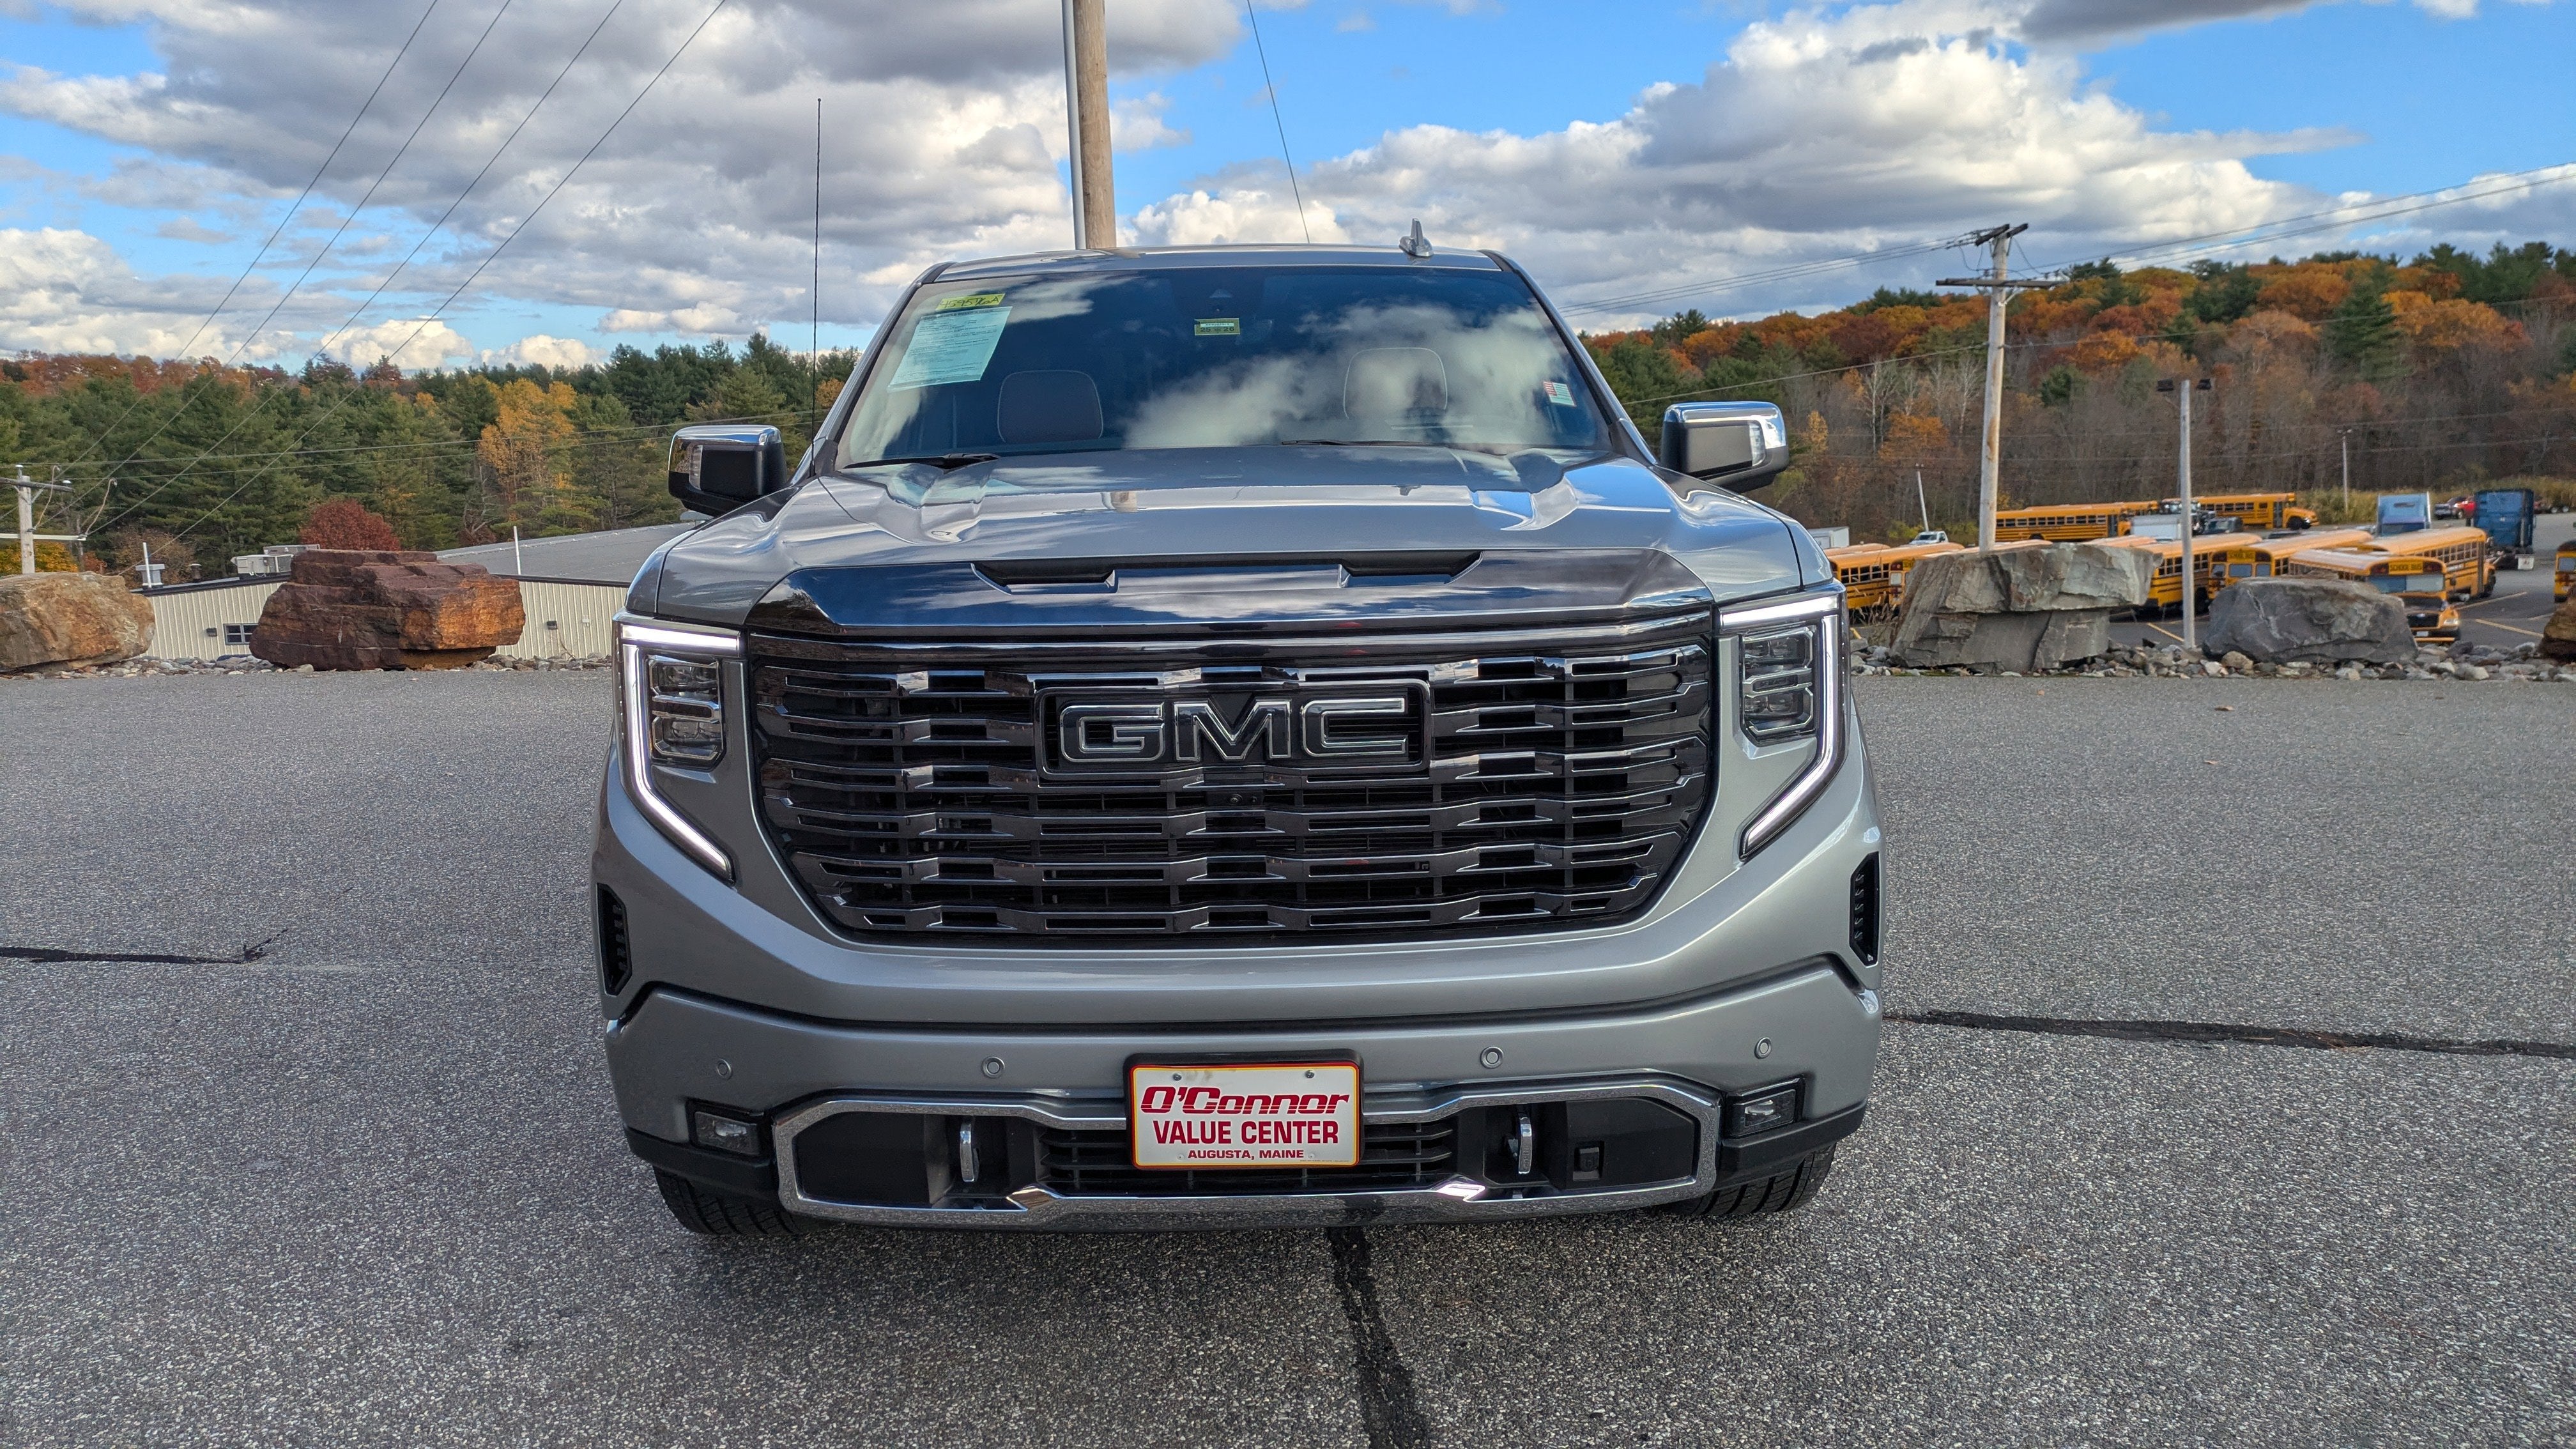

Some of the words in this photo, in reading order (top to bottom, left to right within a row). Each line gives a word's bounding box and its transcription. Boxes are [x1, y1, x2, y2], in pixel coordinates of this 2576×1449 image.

[1060, 696, 1408, 763] GMC
[1140, 1085, 1351, 1115] O'Connor
[1153, 1120, 1232, 1144] VALUE
[1241, 1121, 1339, 1144] CENTER
[1187, 1149, 1255, 1160] AUGUSTA,
[1259, 1149, 1305, 1158] MAINE
